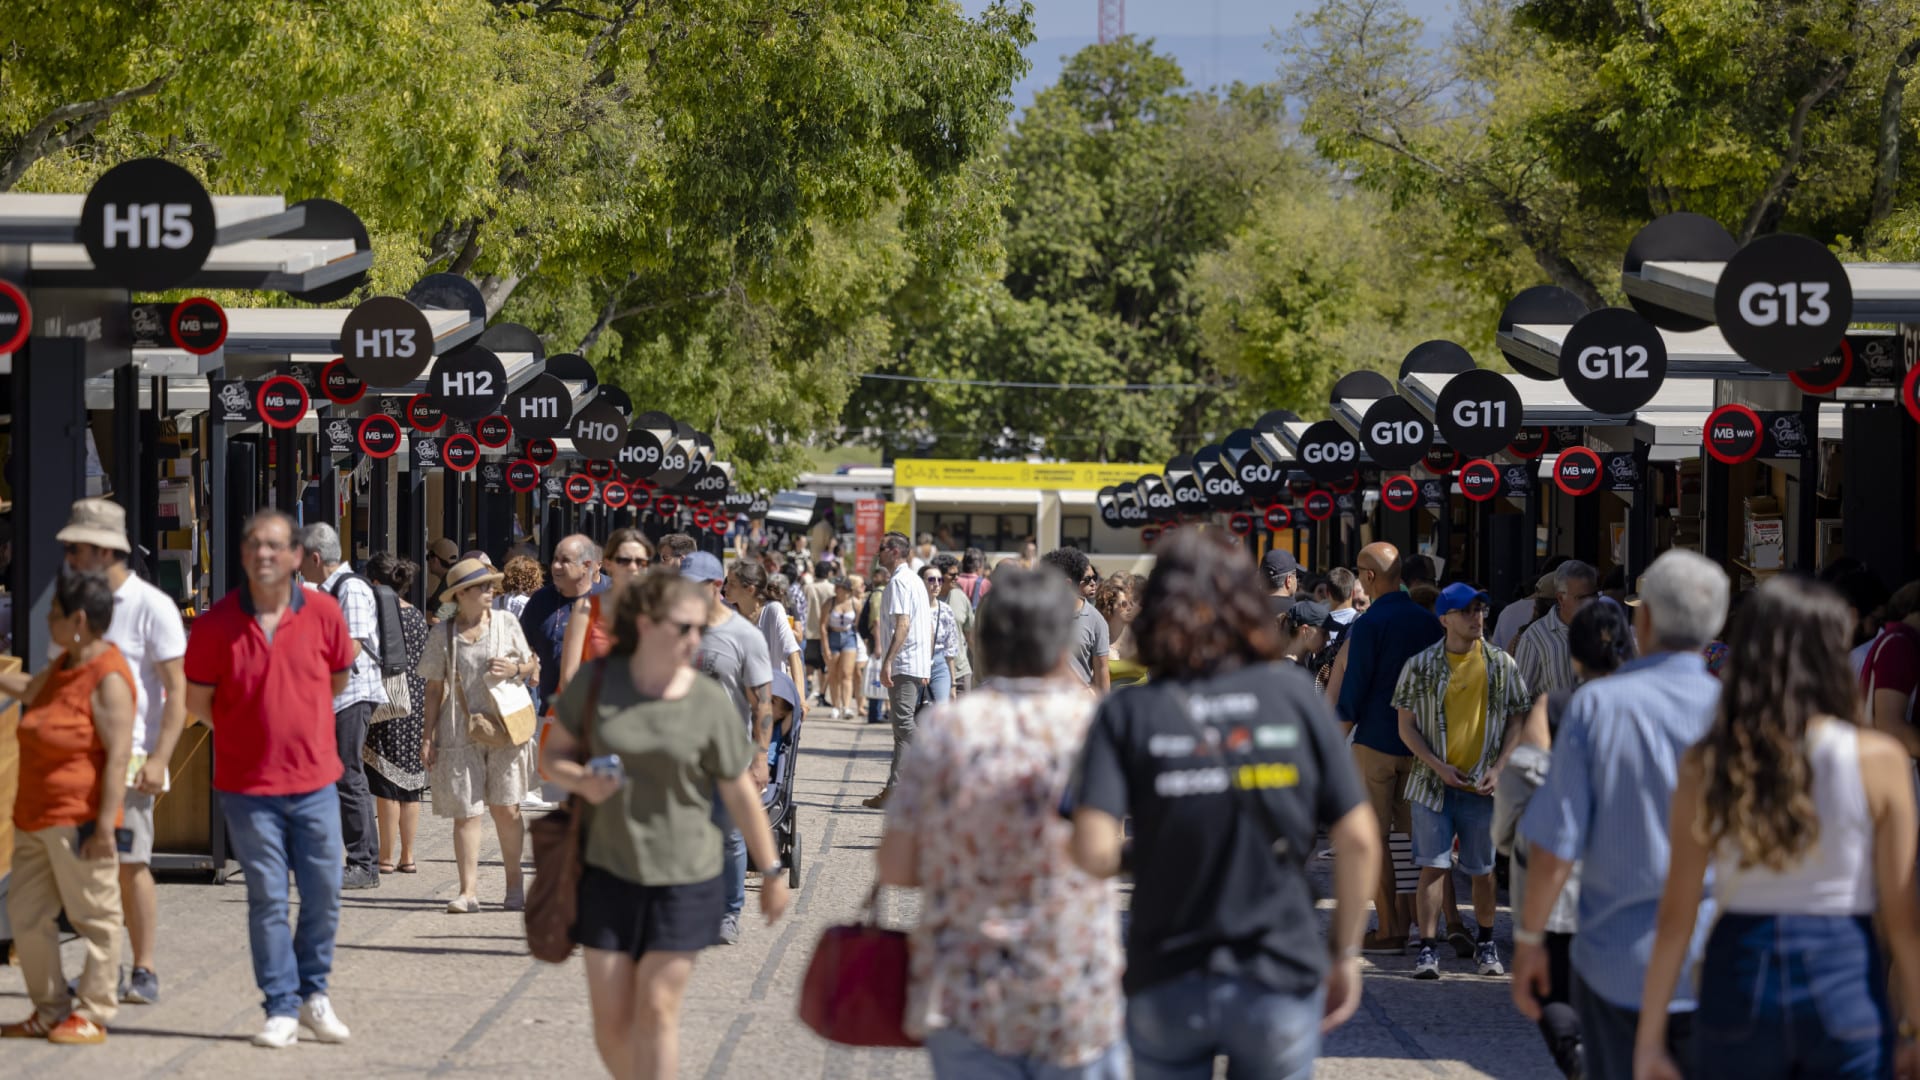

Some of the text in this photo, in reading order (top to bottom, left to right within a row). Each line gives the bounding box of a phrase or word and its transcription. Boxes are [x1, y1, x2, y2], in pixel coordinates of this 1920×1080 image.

[103, 203, 194, 249] H15
[1738, 282, 1830, 326] G13
[181, 320, 200, 331] MB
[356, 328, 416, 358] H13
[1578, 345, 1648, 379] G12
[328, 376, 345, 385] MB
[442, 371, 494, 396] H12
[266, 396, 284, 406] MB
[520, 397, 558, 418] H11
[414, 408, 428, 416] MB
[1452, 400, 1506, 427] G11
[366, 431, 380, 440] MB
[578, 420, 618, 442] H10
[1371, 420, 1424, 445] G10
[1714, 428, 1734, 438] MB
[618, 446, 659, 462] H09
[1304, 441, 1356, 464] G09
[658, 454, 685, 470] 08
[1562, 467, 1579, 475] MB
[1466, 476, 1480, 484] MB
